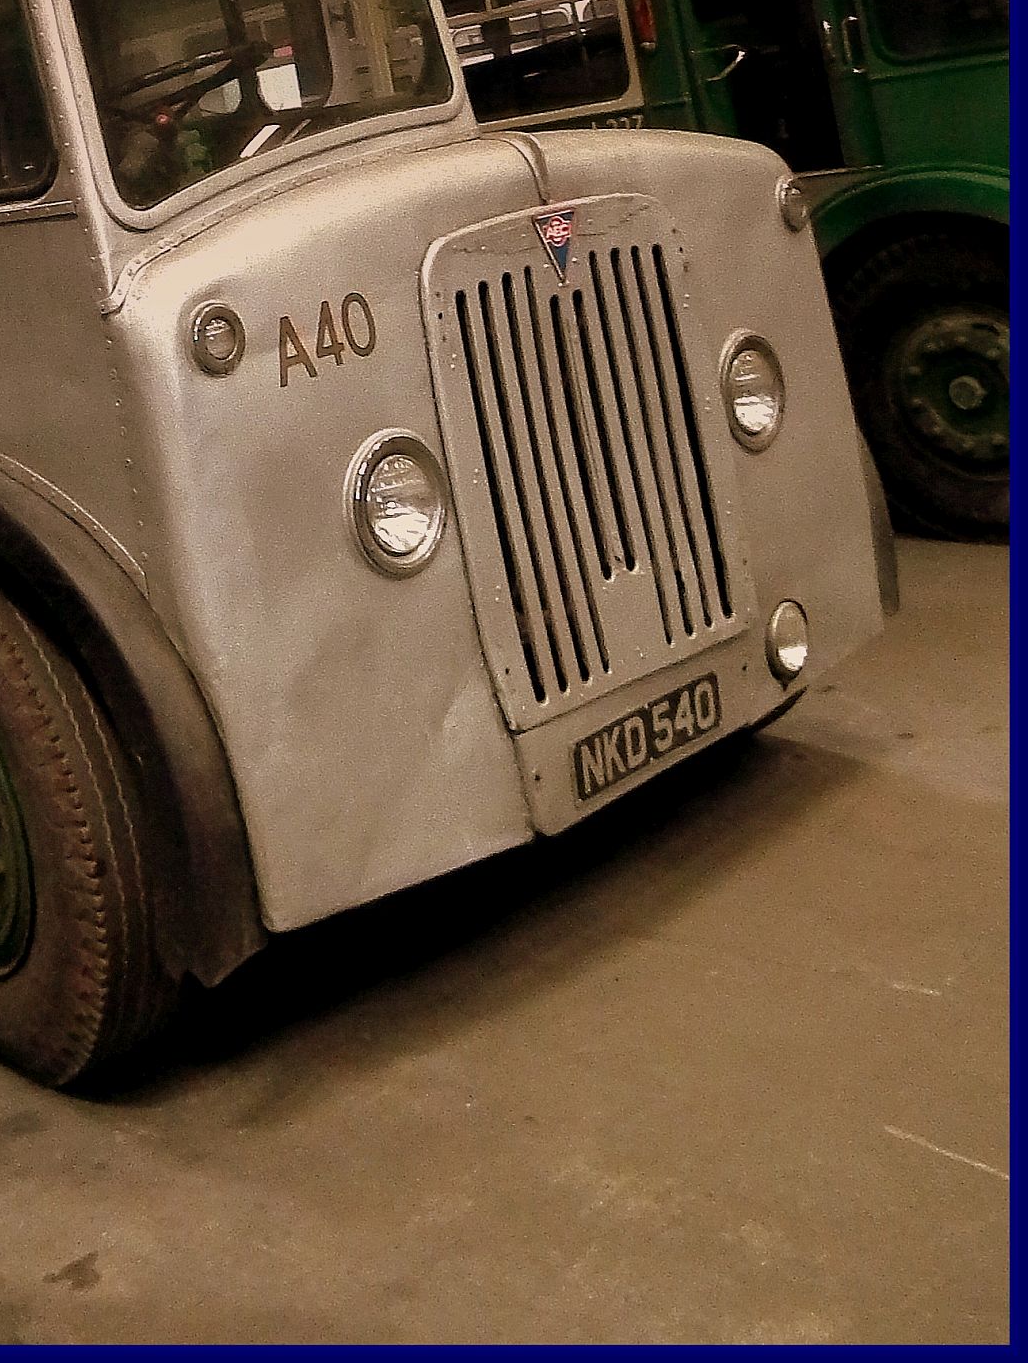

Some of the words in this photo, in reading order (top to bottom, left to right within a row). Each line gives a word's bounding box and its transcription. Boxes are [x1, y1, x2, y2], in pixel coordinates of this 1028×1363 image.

[278, 291, 376, 388] A40
[580, 715, 648, 794] NKD
[652, 679, 717, 752] 540
